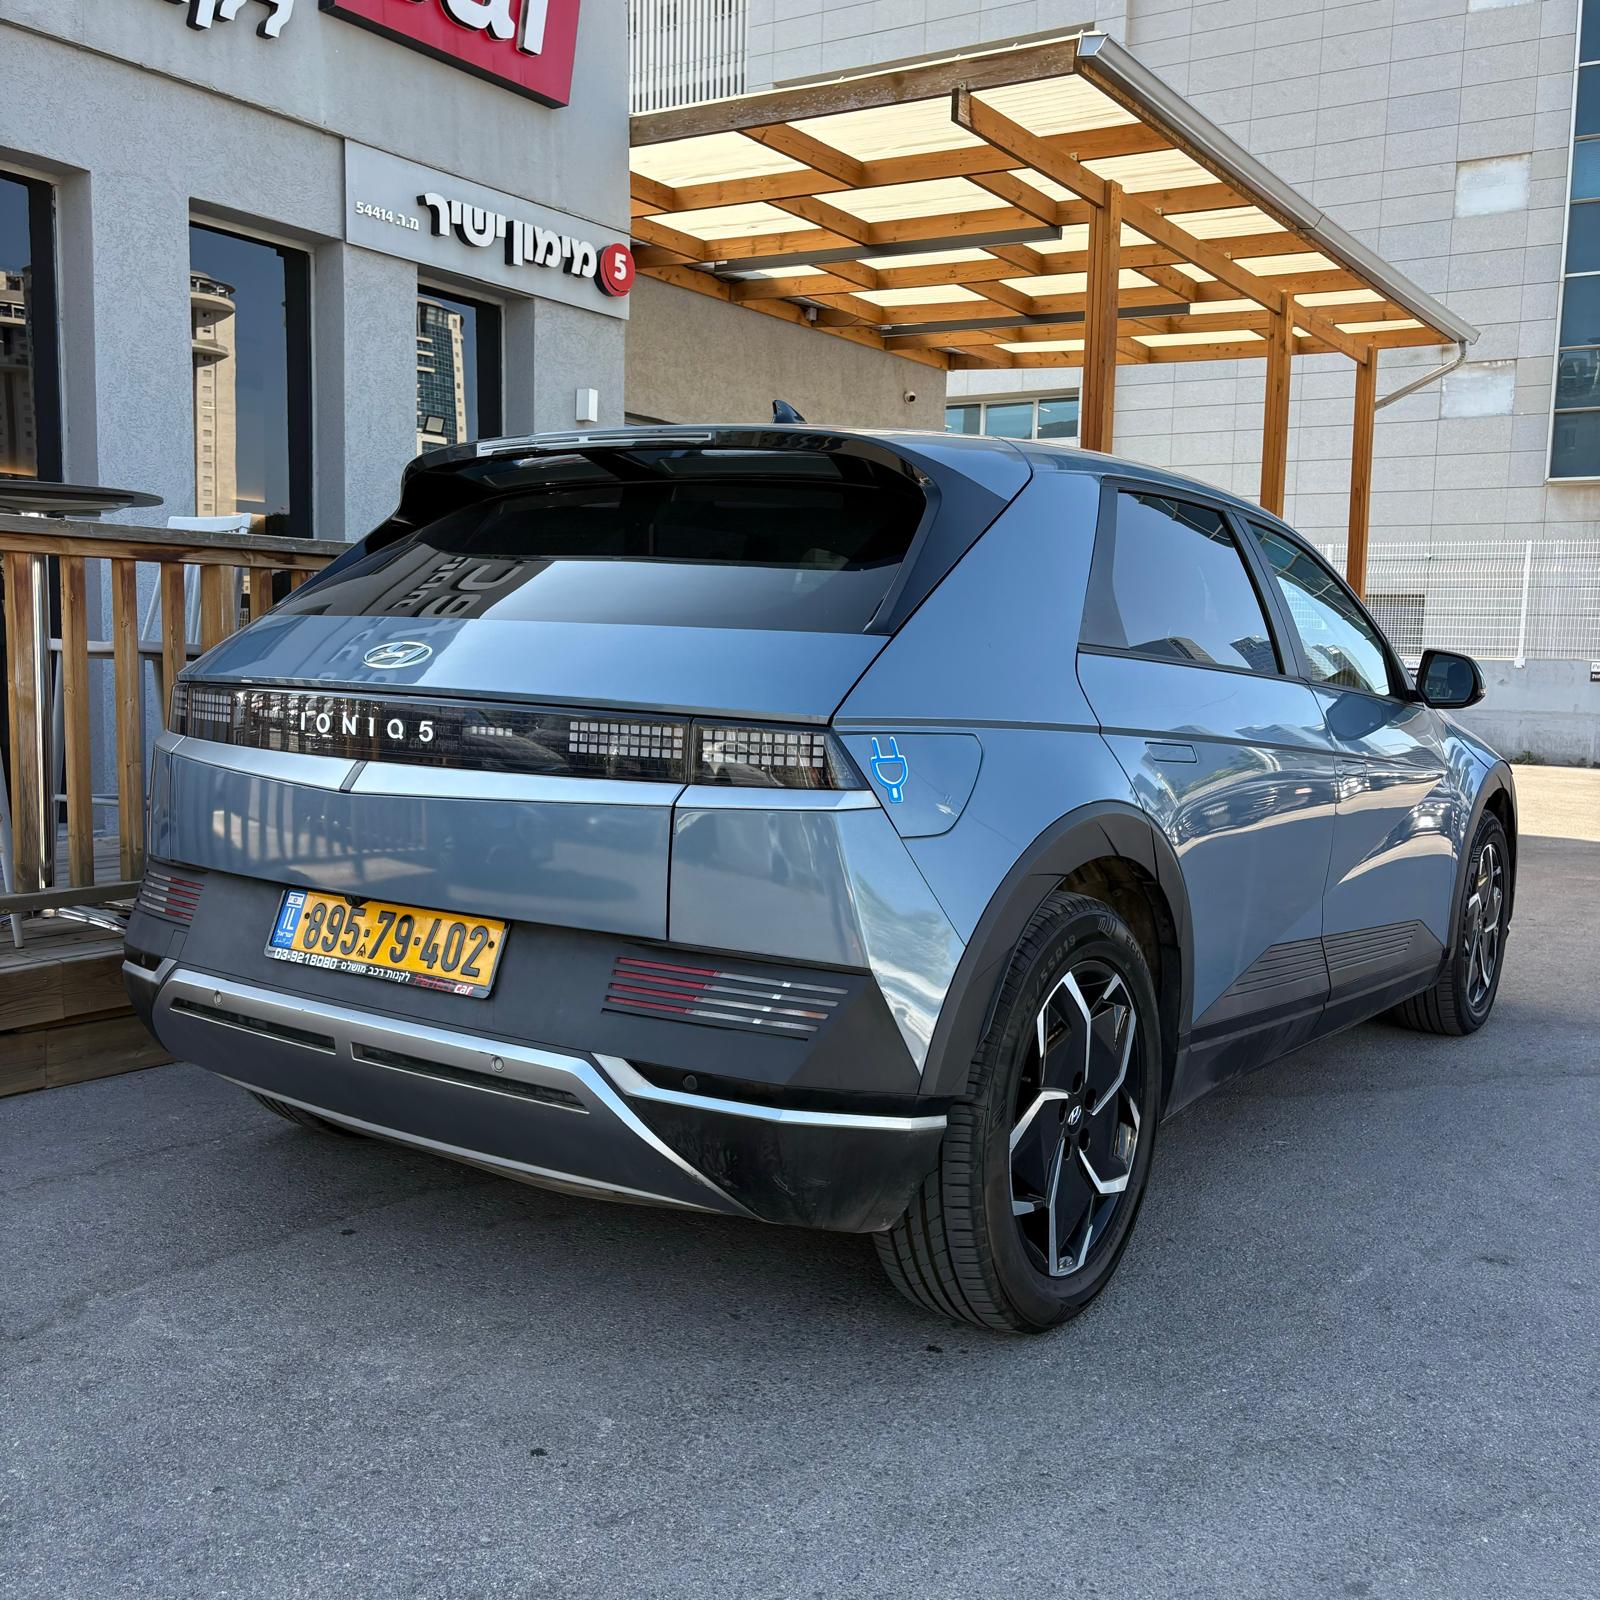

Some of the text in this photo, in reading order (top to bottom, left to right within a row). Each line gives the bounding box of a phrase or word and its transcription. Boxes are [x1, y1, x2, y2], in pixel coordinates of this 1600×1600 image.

[355, 201, 394, 223] 54414
[418, 192, 627, 281] 5 מימון ישיר
[300, 711, 404, 740] IONIQ
[418, 720, 434, 742] 5
[282, 907, 296, 930] IL
[341, 961, 366, 974] מושלם
[454, 984, 473, 995] car
